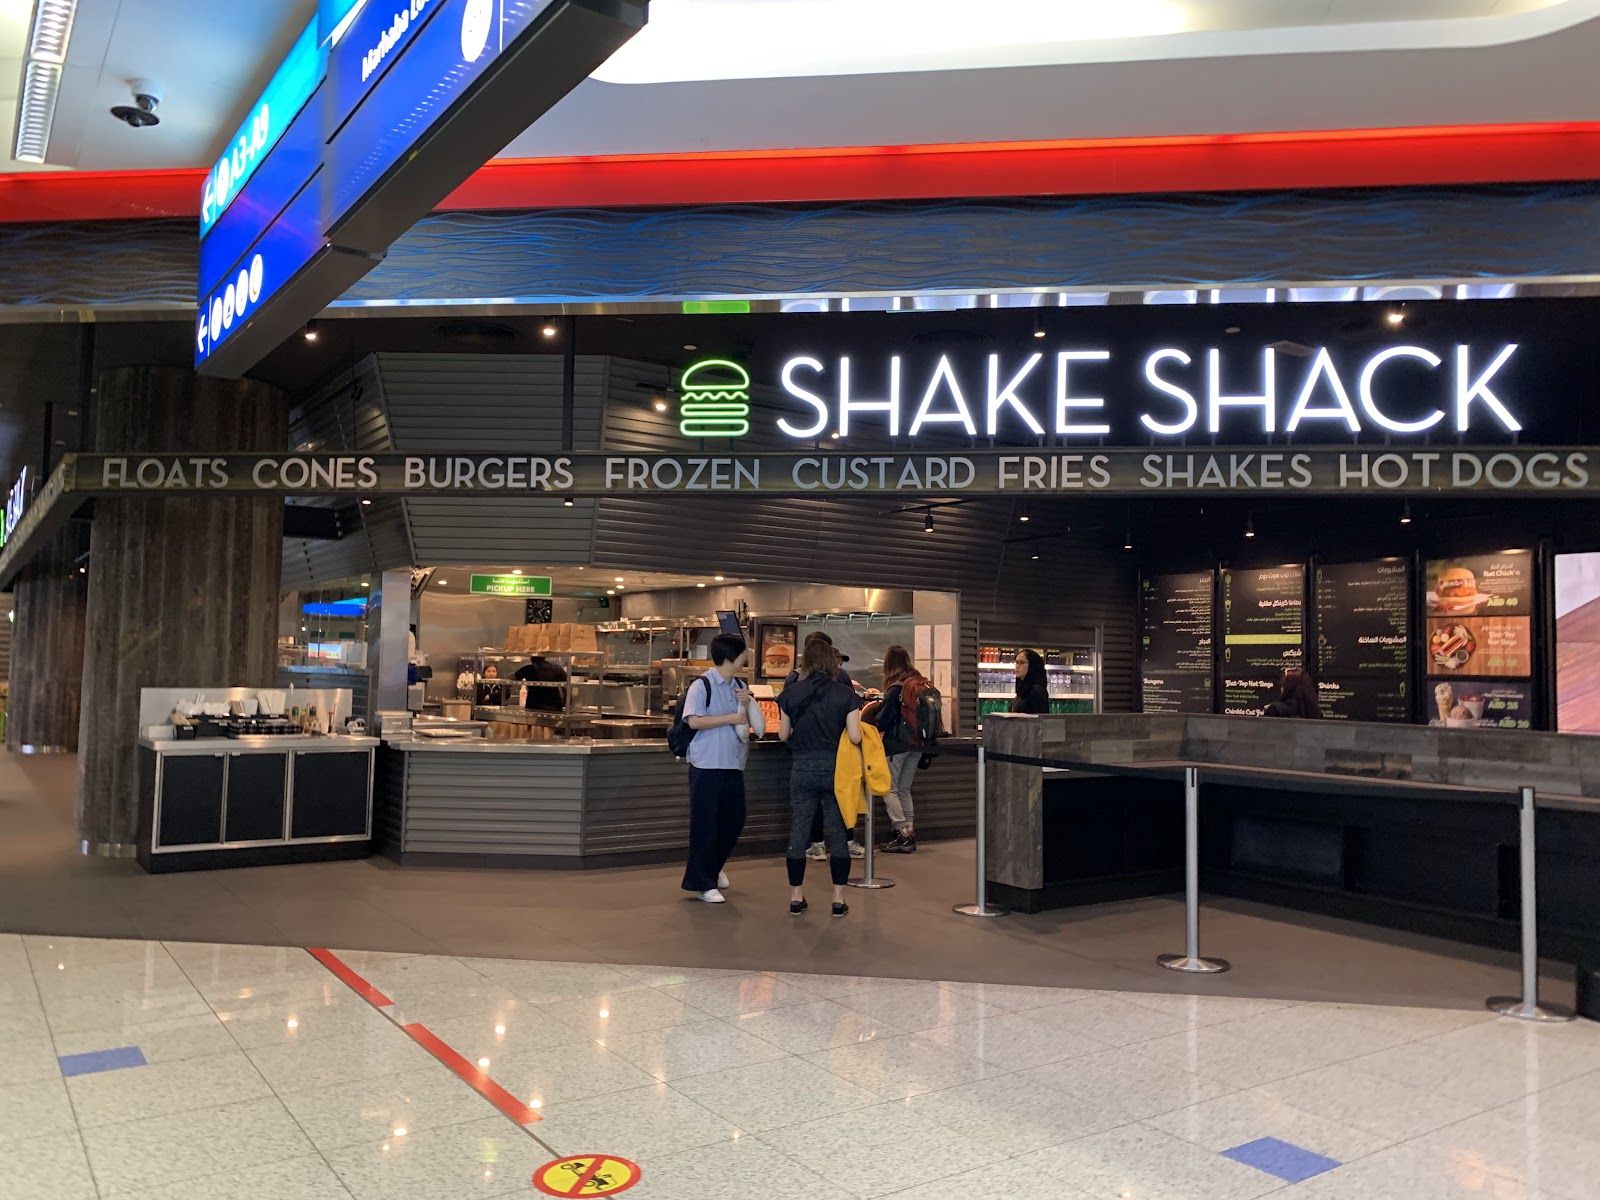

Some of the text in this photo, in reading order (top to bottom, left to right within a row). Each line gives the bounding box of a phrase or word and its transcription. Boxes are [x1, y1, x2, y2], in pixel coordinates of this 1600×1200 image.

[362, 0, 430, 82] Marhaba Lo
[229, 103, 269, 188] A3-A9
[776, 343, 1522, 438] SHAKE SHACK
[102, 452, 1589, 490] FLOATS CONES BURGERS FROZEN CUSTARD FRIES SHAKES HOT DOGS
[486, 584, 535, 593] PICKUP HERE
[1259, 680, 1274, 689] Dogs
[1318, 682, 1340, 690] Drinks
[1224, 707, 1245, 715] Crinkle
[1245, 708, 1256, 716] Cut
